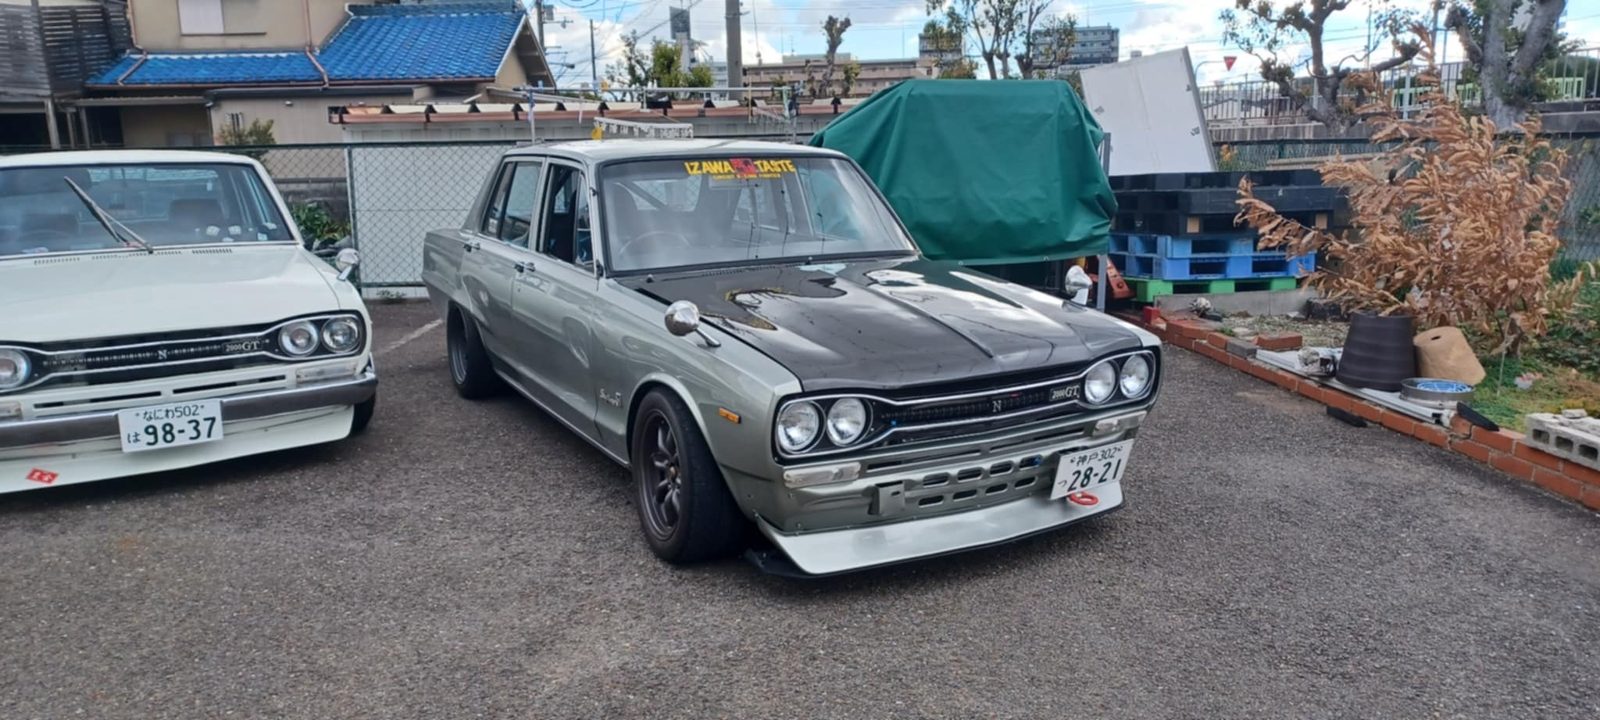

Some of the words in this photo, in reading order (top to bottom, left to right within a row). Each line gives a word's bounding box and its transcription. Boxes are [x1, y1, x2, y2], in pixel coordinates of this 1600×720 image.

[684, 160, 735, 175] IZAWA
[753, 159, 796, 173] TASTE
[225, 340, 260, 352] 2000GT
[1052, 384, 1080, 400] 2000GT
[127, 431, 141, 444] は
[144, 416, 217, 446] 98-37
[1057, 479, 1068, 488] つ
[1067, 458, 1122, 493] 28-21
